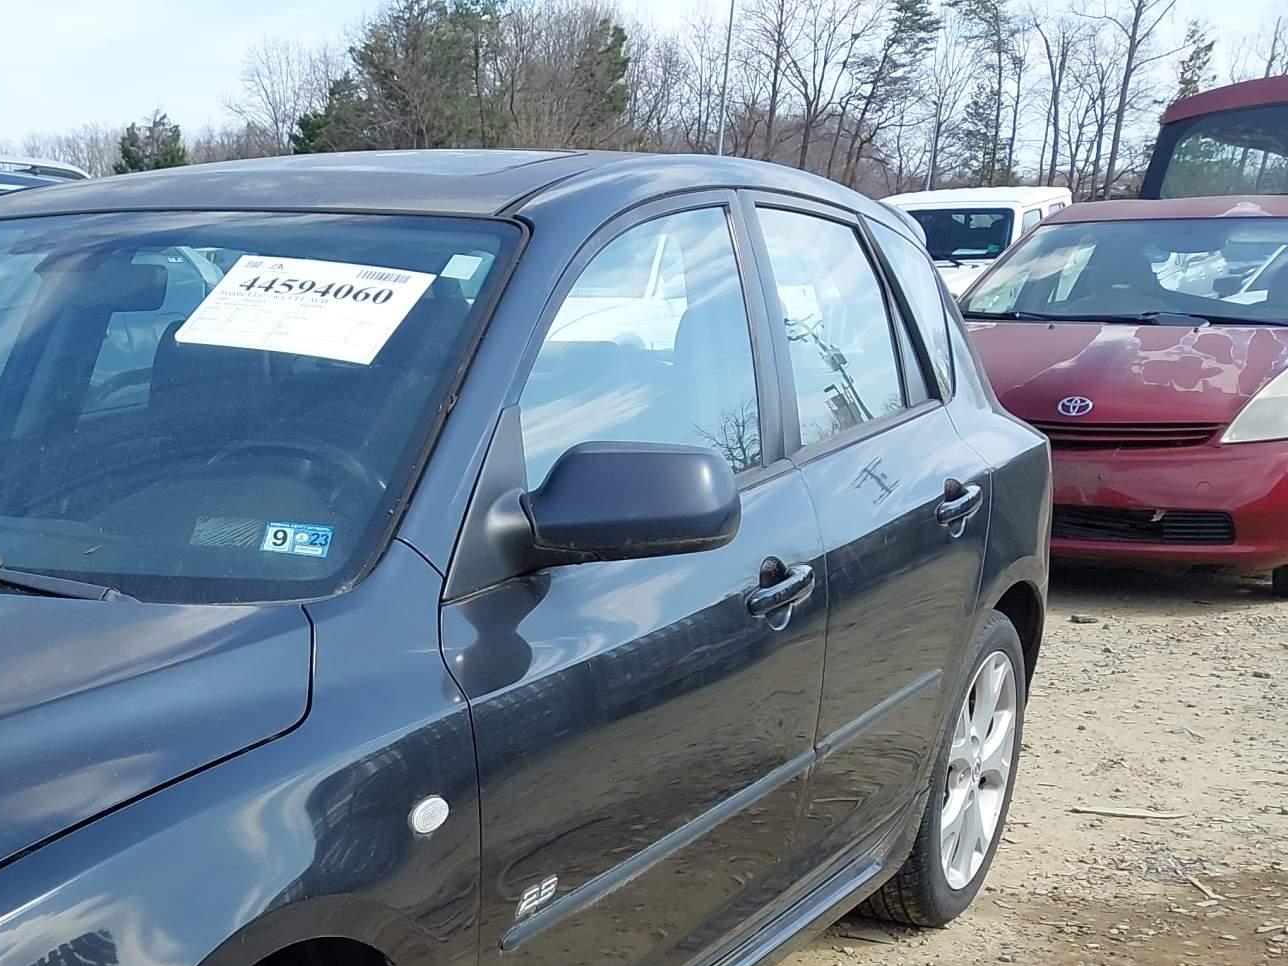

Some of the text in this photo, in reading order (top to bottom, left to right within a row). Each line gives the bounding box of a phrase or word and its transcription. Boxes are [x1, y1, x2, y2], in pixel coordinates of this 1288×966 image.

[238, 275, 394, 305] 44594060
[272, 529, 329, 547] 9 23
